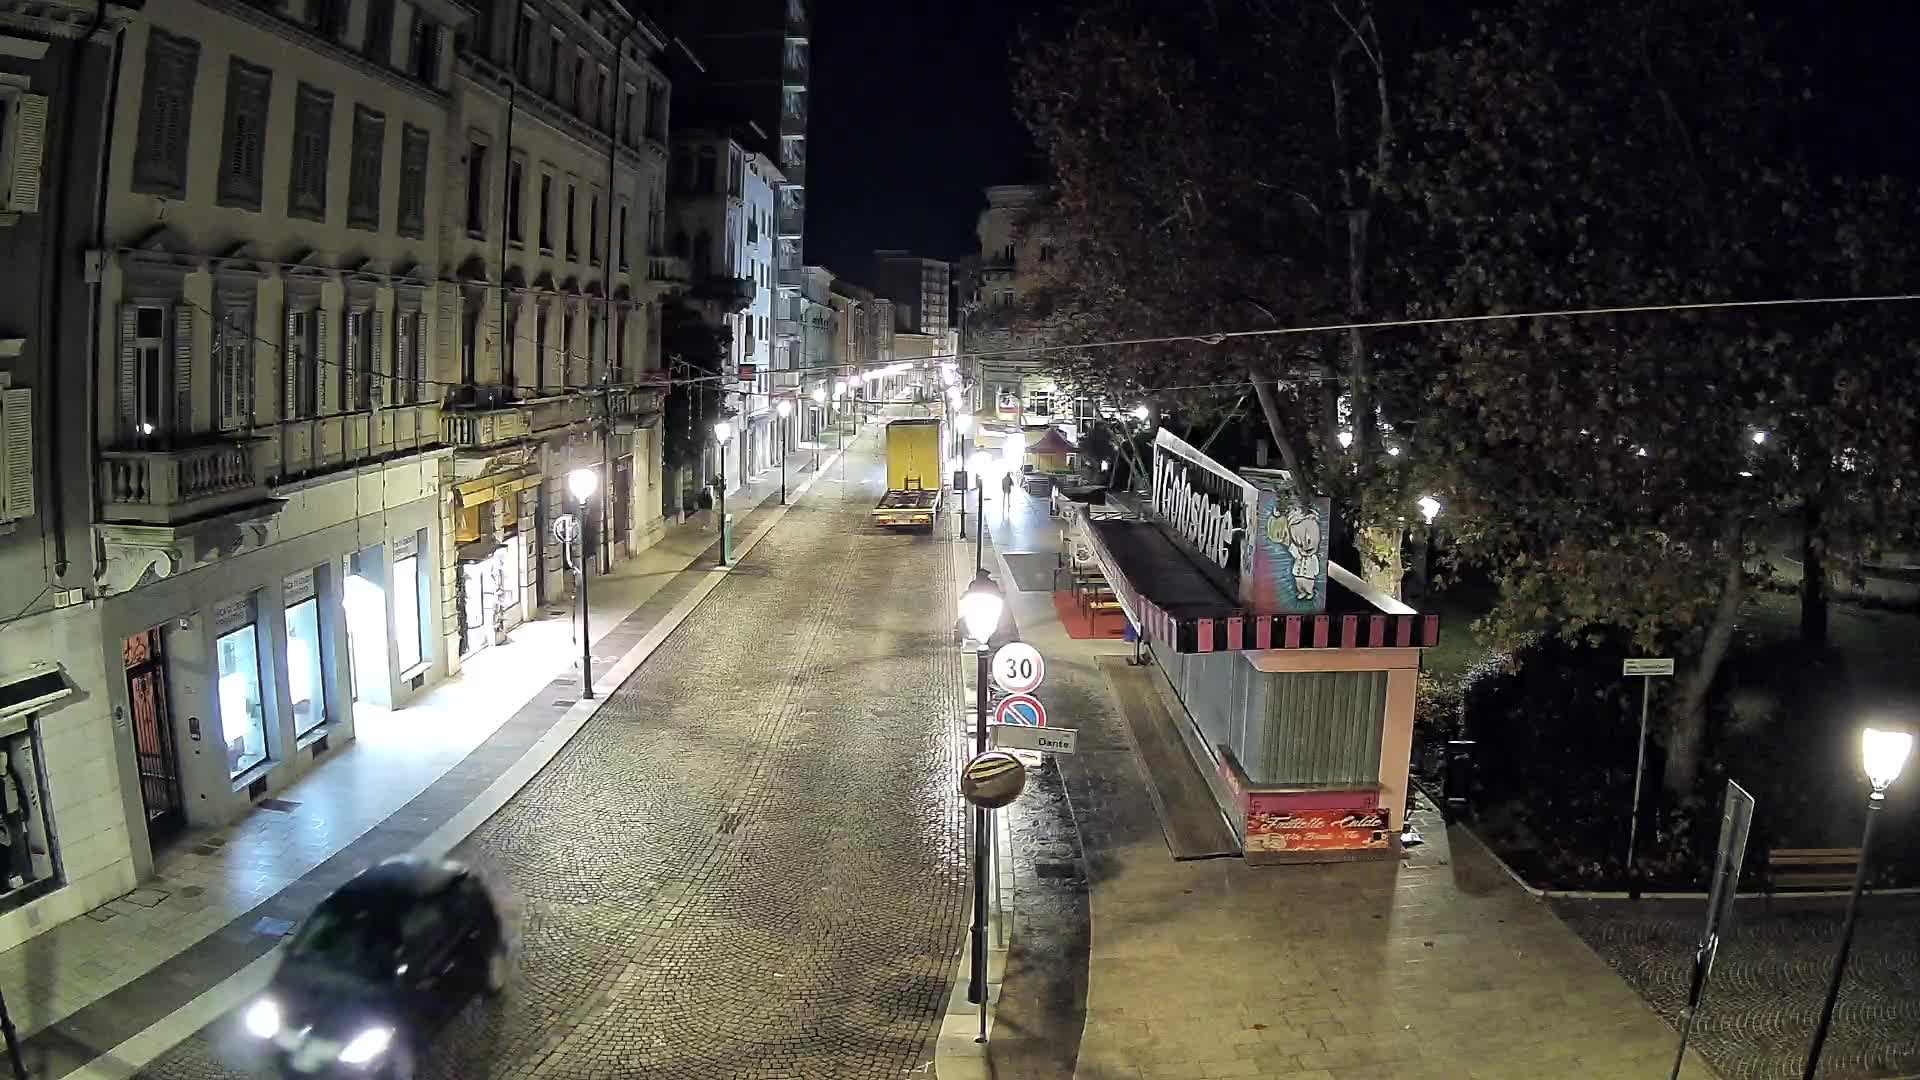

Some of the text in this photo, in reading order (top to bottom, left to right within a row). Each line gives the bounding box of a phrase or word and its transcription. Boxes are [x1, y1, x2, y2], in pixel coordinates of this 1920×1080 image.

[1162, 458, 1233, 569] Golosone
[1006, 658, 1032, 679] 30
[1038, 737, 1069, 749] Dante
